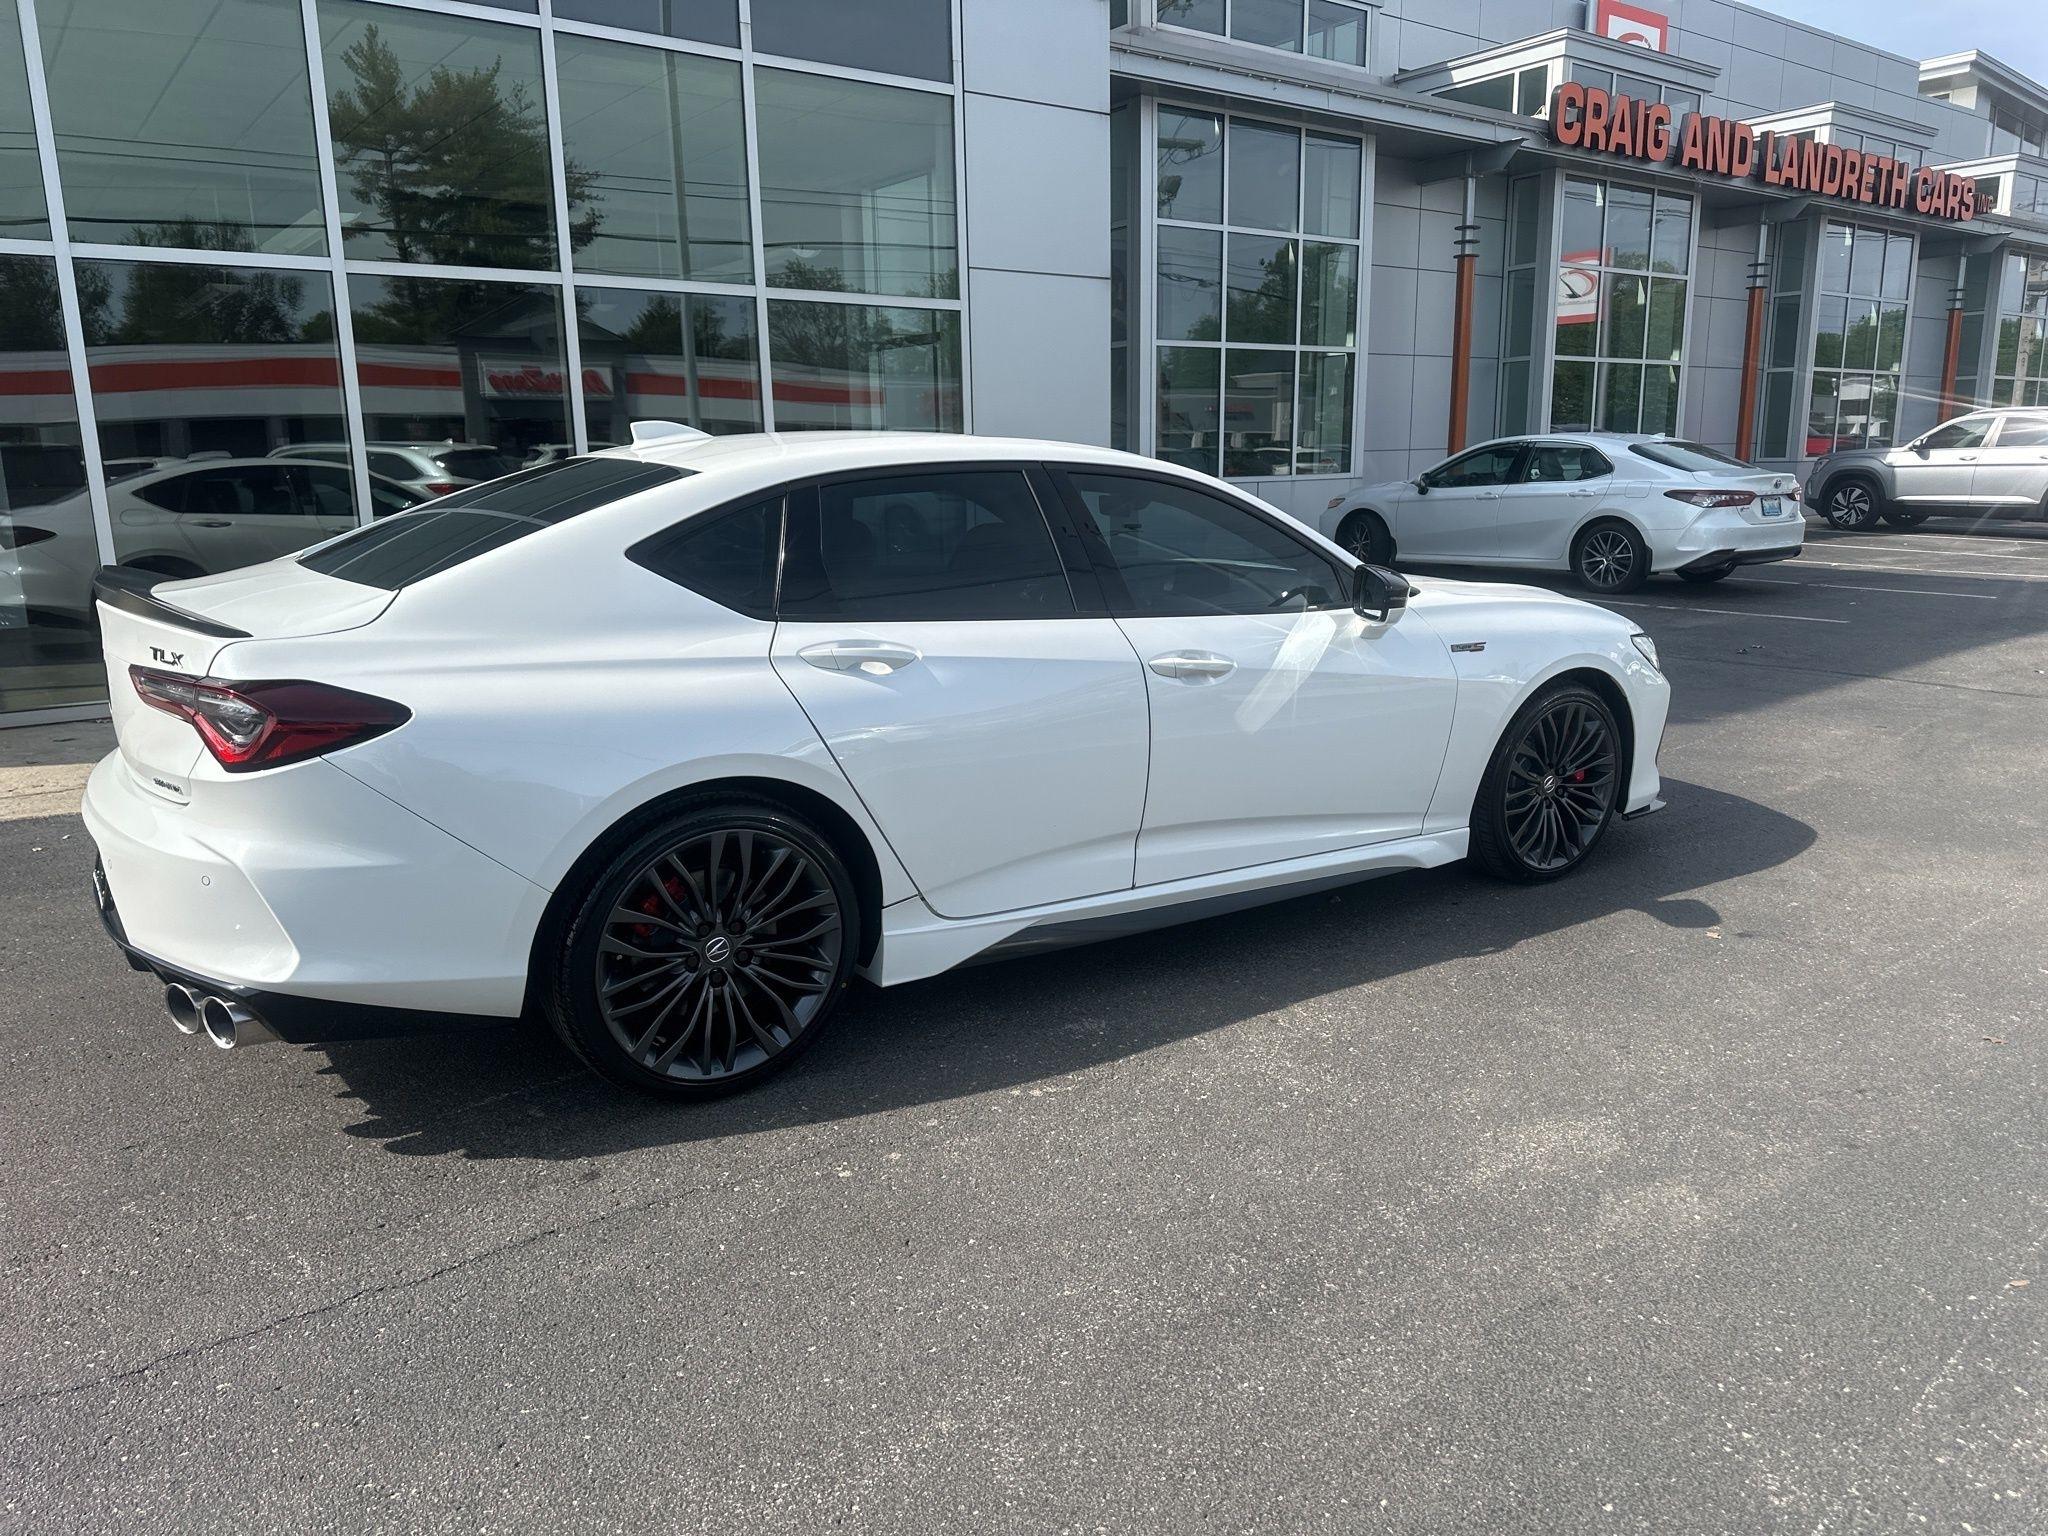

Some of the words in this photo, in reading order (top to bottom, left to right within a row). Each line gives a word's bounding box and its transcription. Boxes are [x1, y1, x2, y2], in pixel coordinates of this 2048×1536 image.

[1554, 82, 1671, 162] CRAIG
[1682, 112, 1754, 178] AND
[1761, 130, 1908, 209] LANDRETH
[1915, 166, 1976, 222] CARS
[149, 646, 184, 669] TLX
